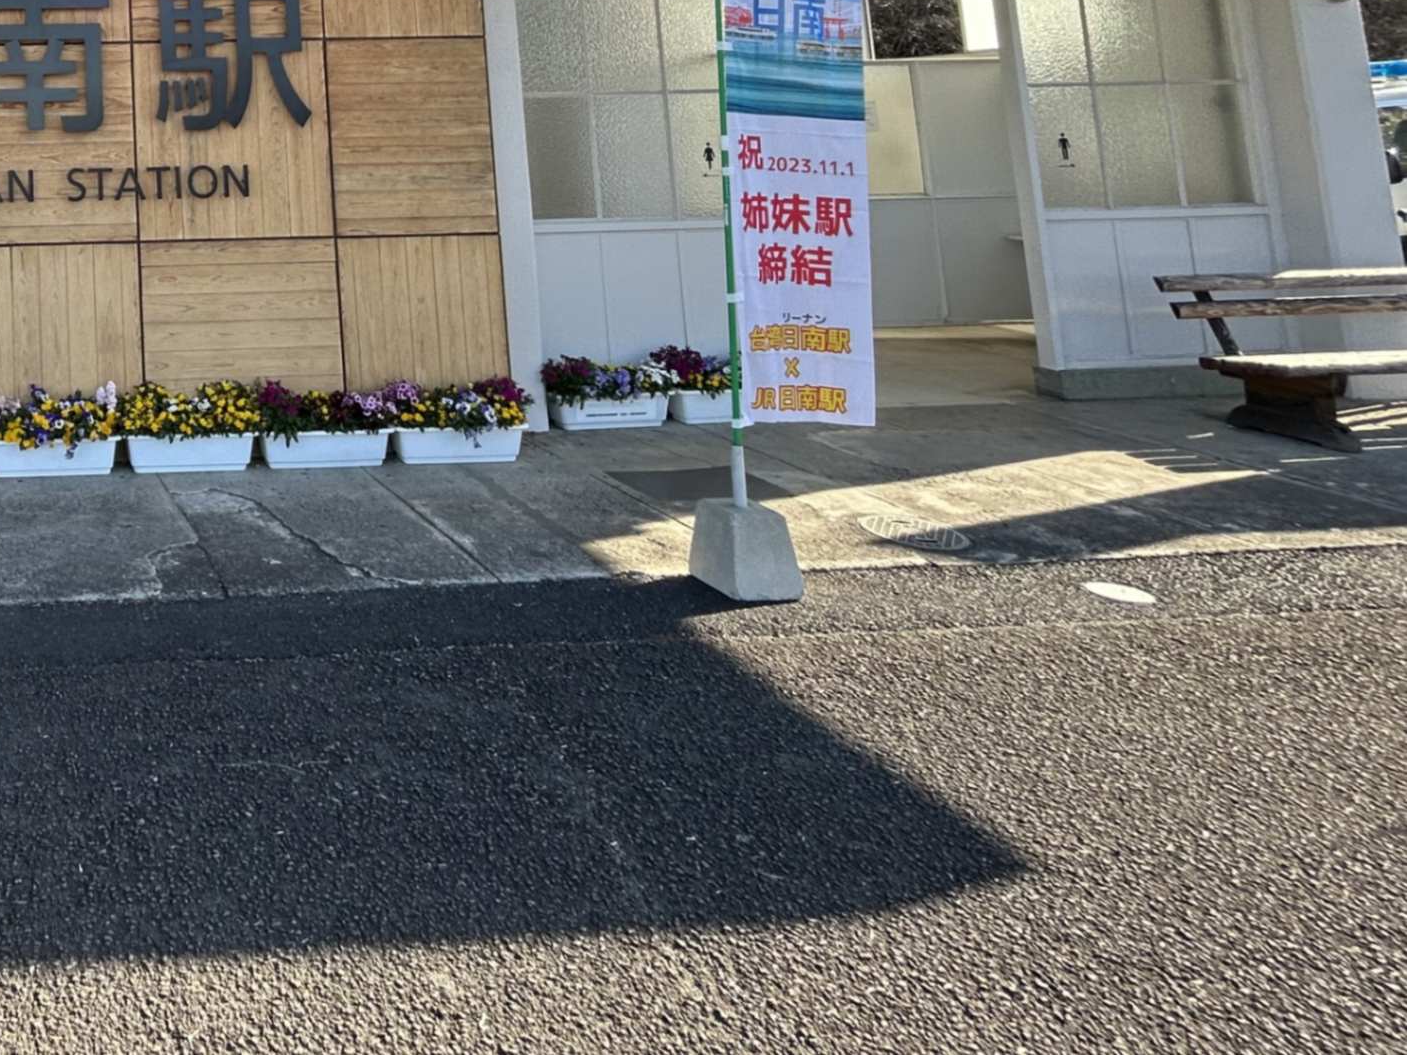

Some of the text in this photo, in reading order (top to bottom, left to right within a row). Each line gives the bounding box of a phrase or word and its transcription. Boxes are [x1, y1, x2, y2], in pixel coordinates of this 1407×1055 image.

[737, 133, 855, 177] 祝 2023.11.1
[66, 163, 251, 203] STATION
[740, 191, 854, 238] 姉妹駅
[758, 242, 834, 288] 締結
[749, 323, 851, 354] 台湾日南駅
[782, 312, 827, 325] リーナン
